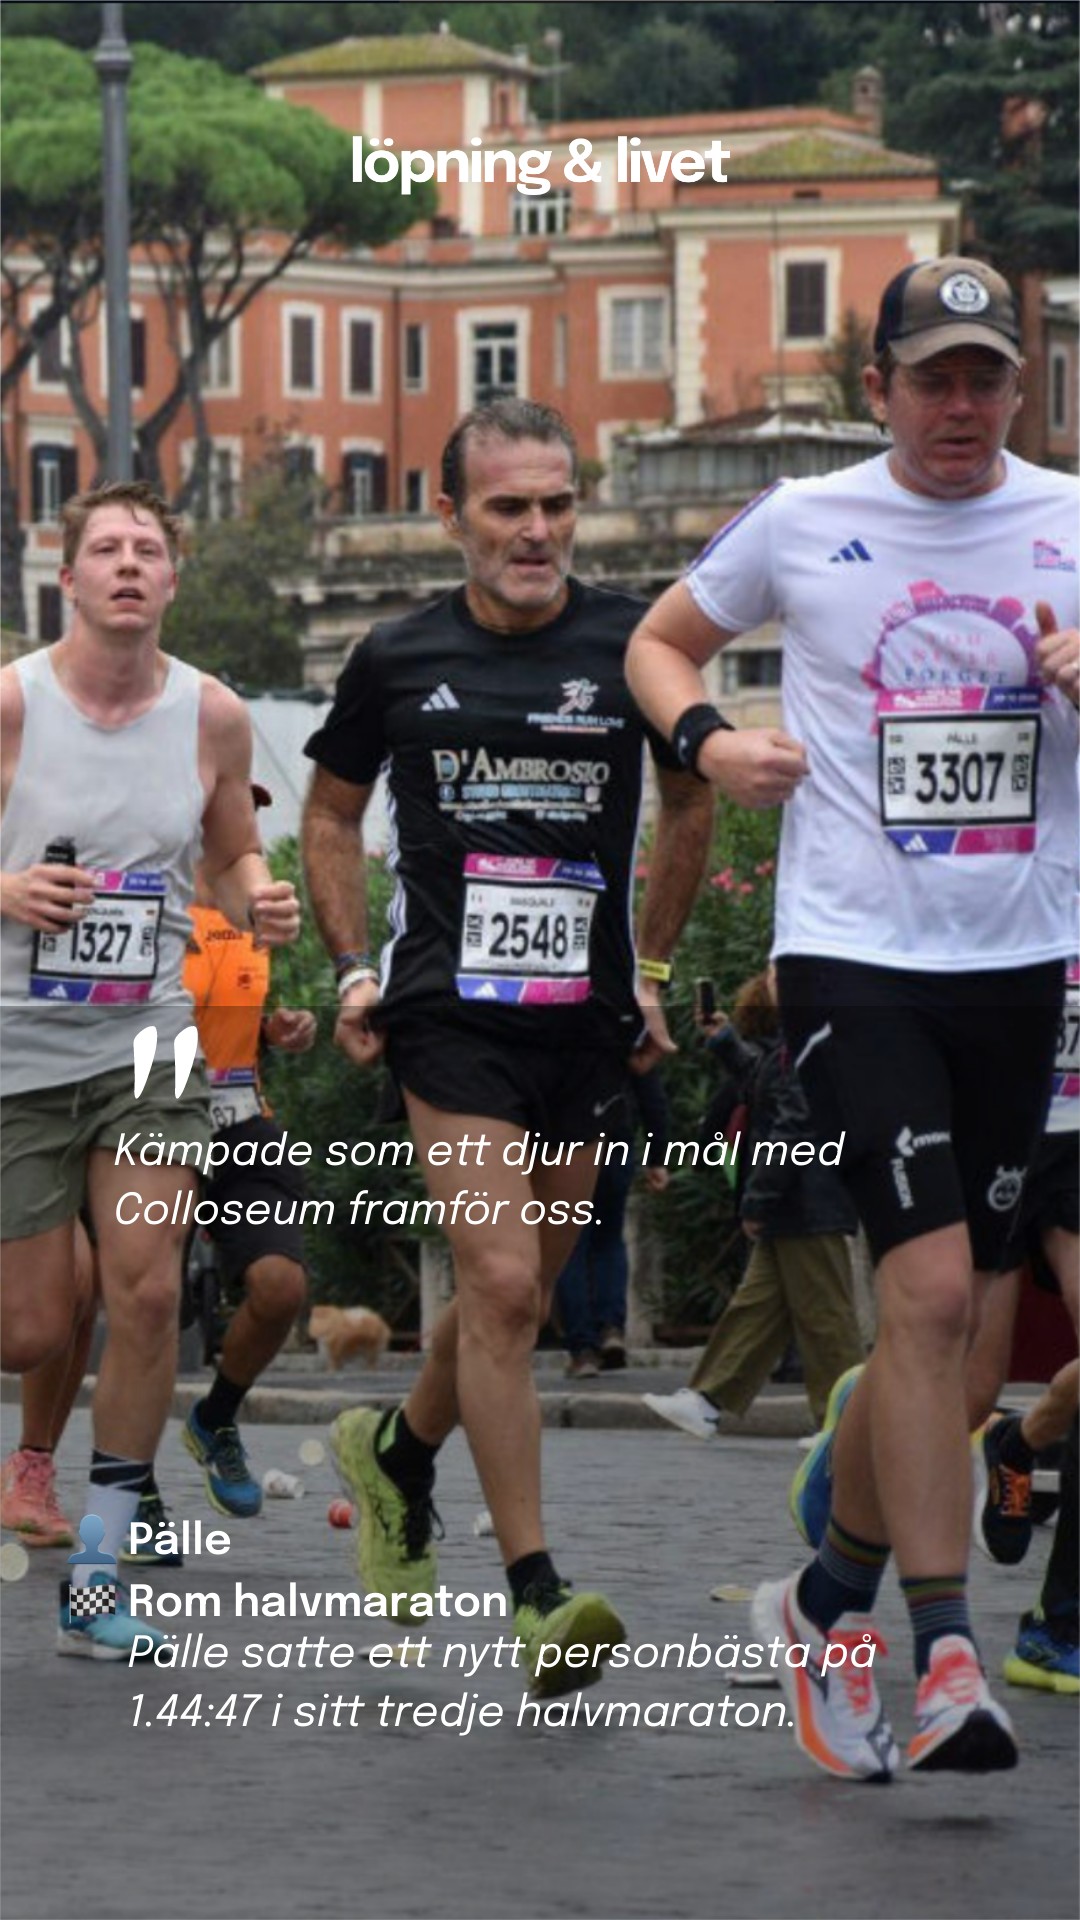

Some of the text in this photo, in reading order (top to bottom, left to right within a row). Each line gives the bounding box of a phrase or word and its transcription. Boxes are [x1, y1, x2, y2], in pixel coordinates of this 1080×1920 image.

[915, 751, 1005, 804] 3307
[70, 921, 132, 964] 1327
[488, 912, 568, 959] 2548
